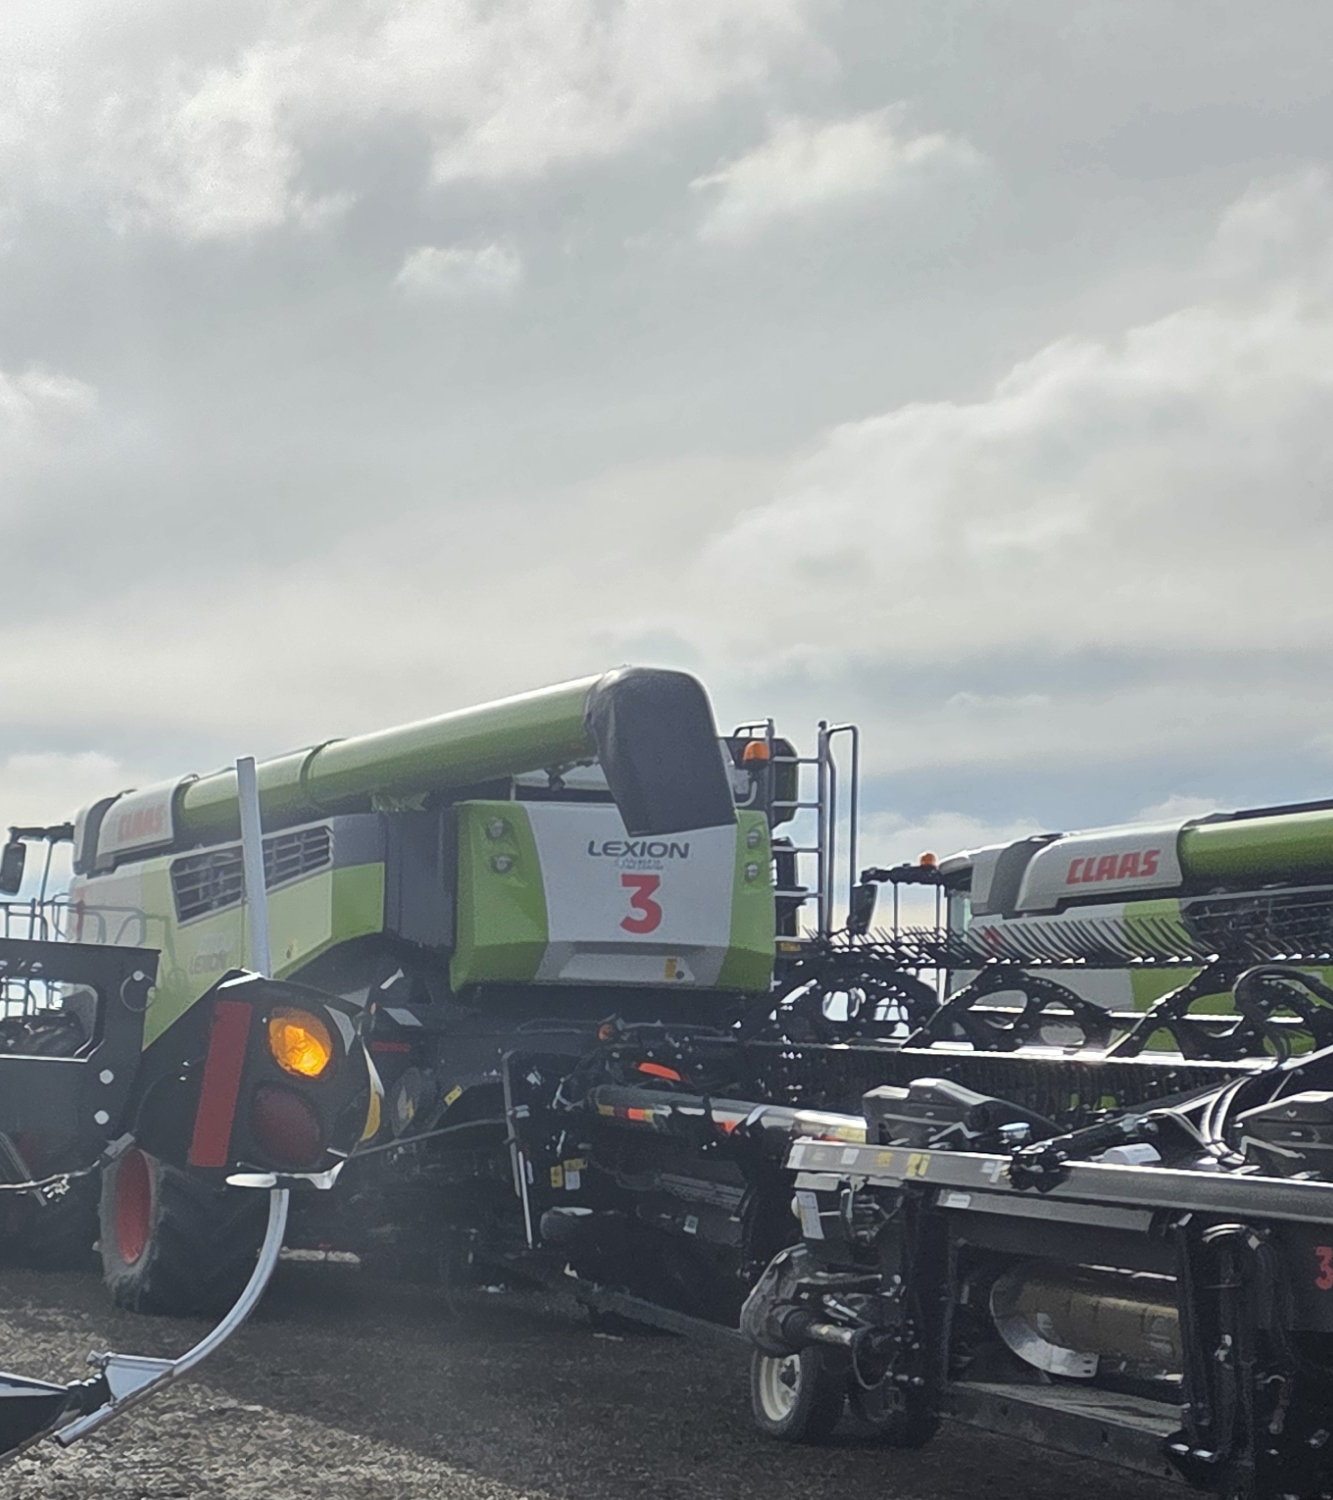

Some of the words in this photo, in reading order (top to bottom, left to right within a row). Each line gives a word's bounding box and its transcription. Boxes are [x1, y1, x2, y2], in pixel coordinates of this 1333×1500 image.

[588, 840, 690, 859] LEXION
[1065, 849, 1161, 885] CLAAS
[619, 873, 663, 934] 3
